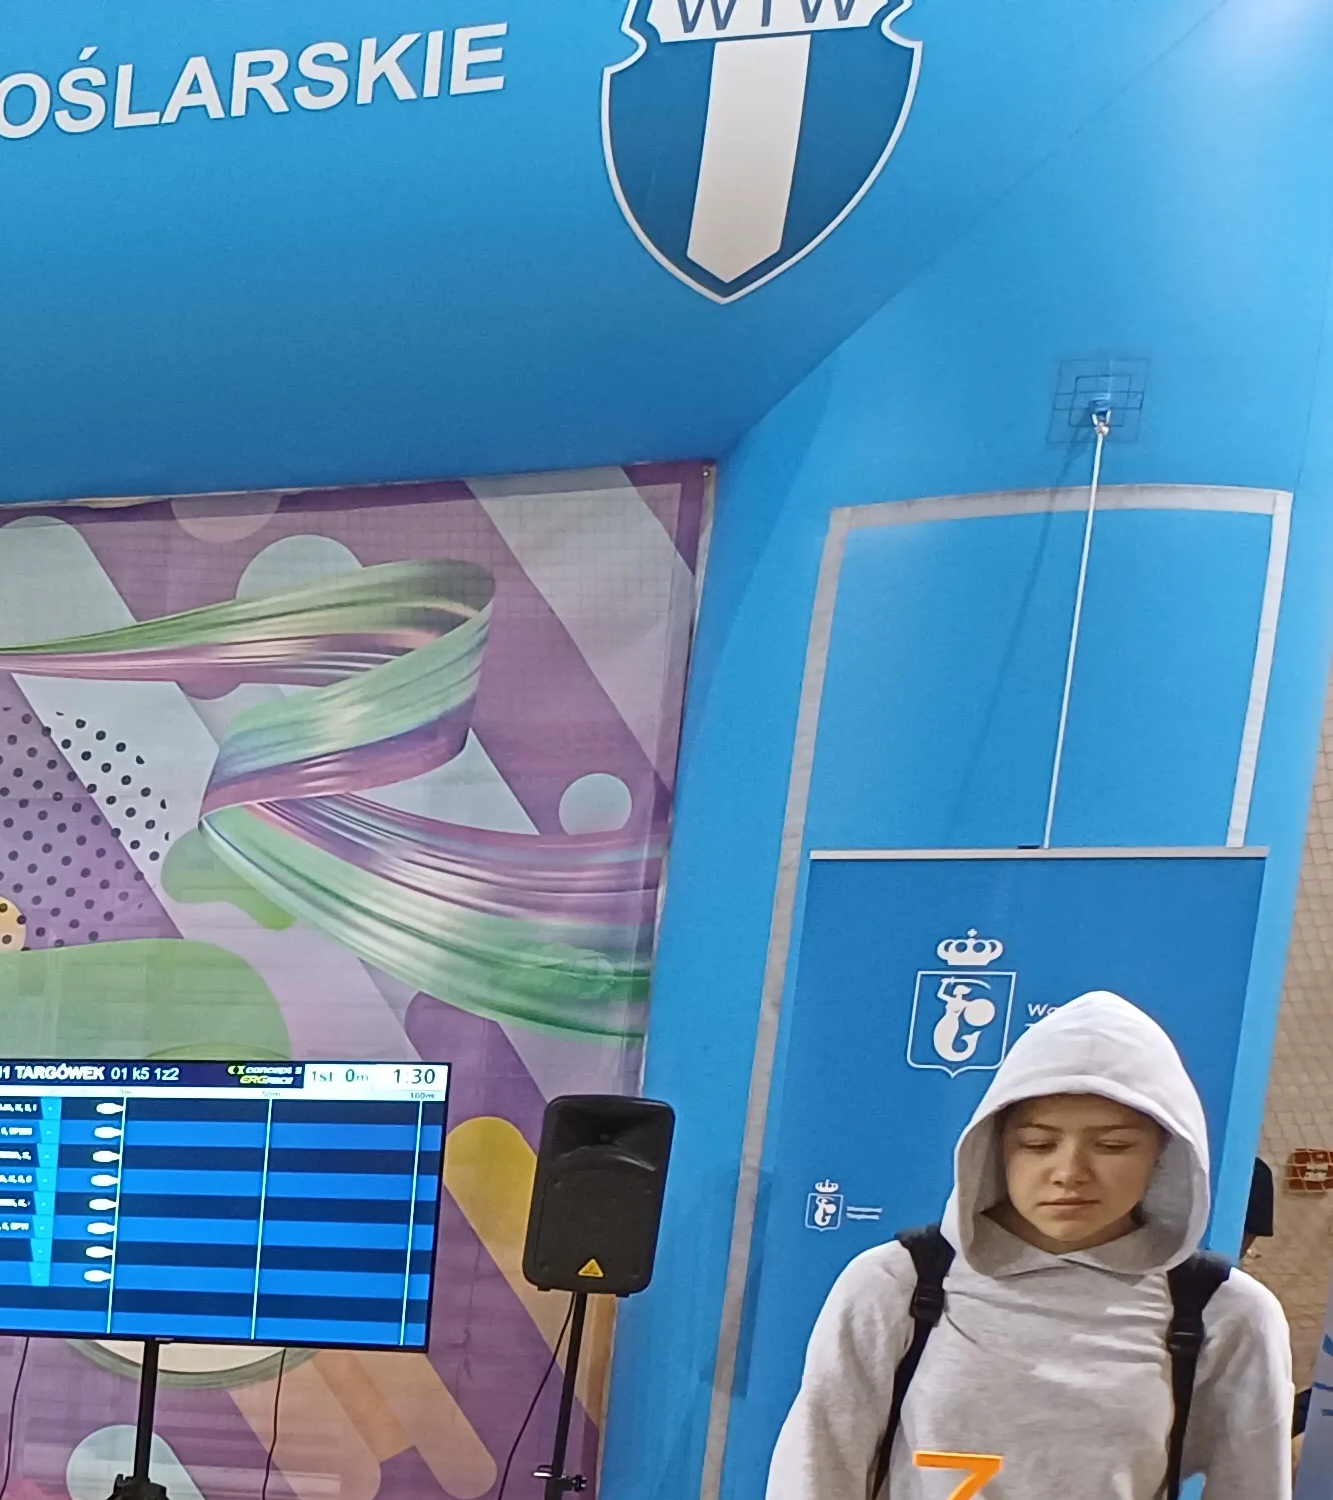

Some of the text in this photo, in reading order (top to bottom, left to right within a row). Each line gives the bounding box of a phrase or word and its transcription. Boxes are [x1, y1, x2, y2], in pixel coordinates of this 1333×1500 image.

[14, 1063, 105, 1080] TARGÓWEK
[110, 1067, 128, 1080] 01
[132, 1066, 150, 1080] k5
[154, 1067, 180, 1081] 1z2
[311, 1070, 333, 1082] 1st
[344, 1068, 369, 1082] 0m
[392, 1067, 436, 1085] 1:30
